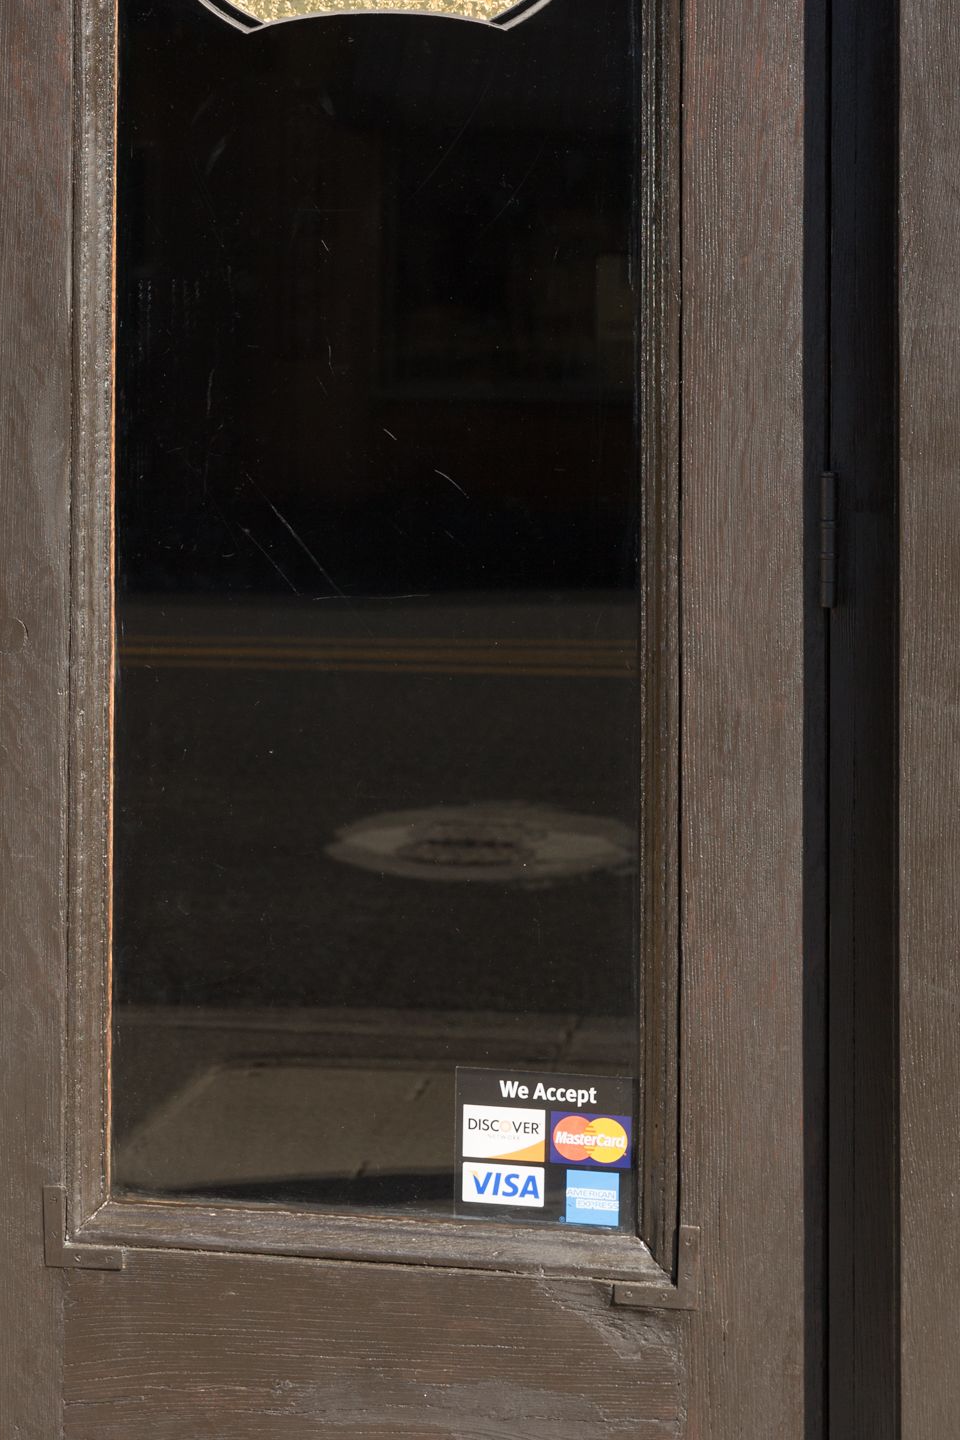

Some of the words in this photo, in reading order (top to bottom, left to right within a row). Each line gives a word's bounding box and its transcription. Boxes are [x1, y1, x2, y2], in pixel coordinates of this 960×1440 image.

[499, 1080, 529, 1099] We
[533, 1082, 597, 1107] Accept
[555, 1131, 625, 1149] MasterCard
[471, 1171, 540, 1199] VISA
[566, 1188, 615, 1200] AMERICAN
